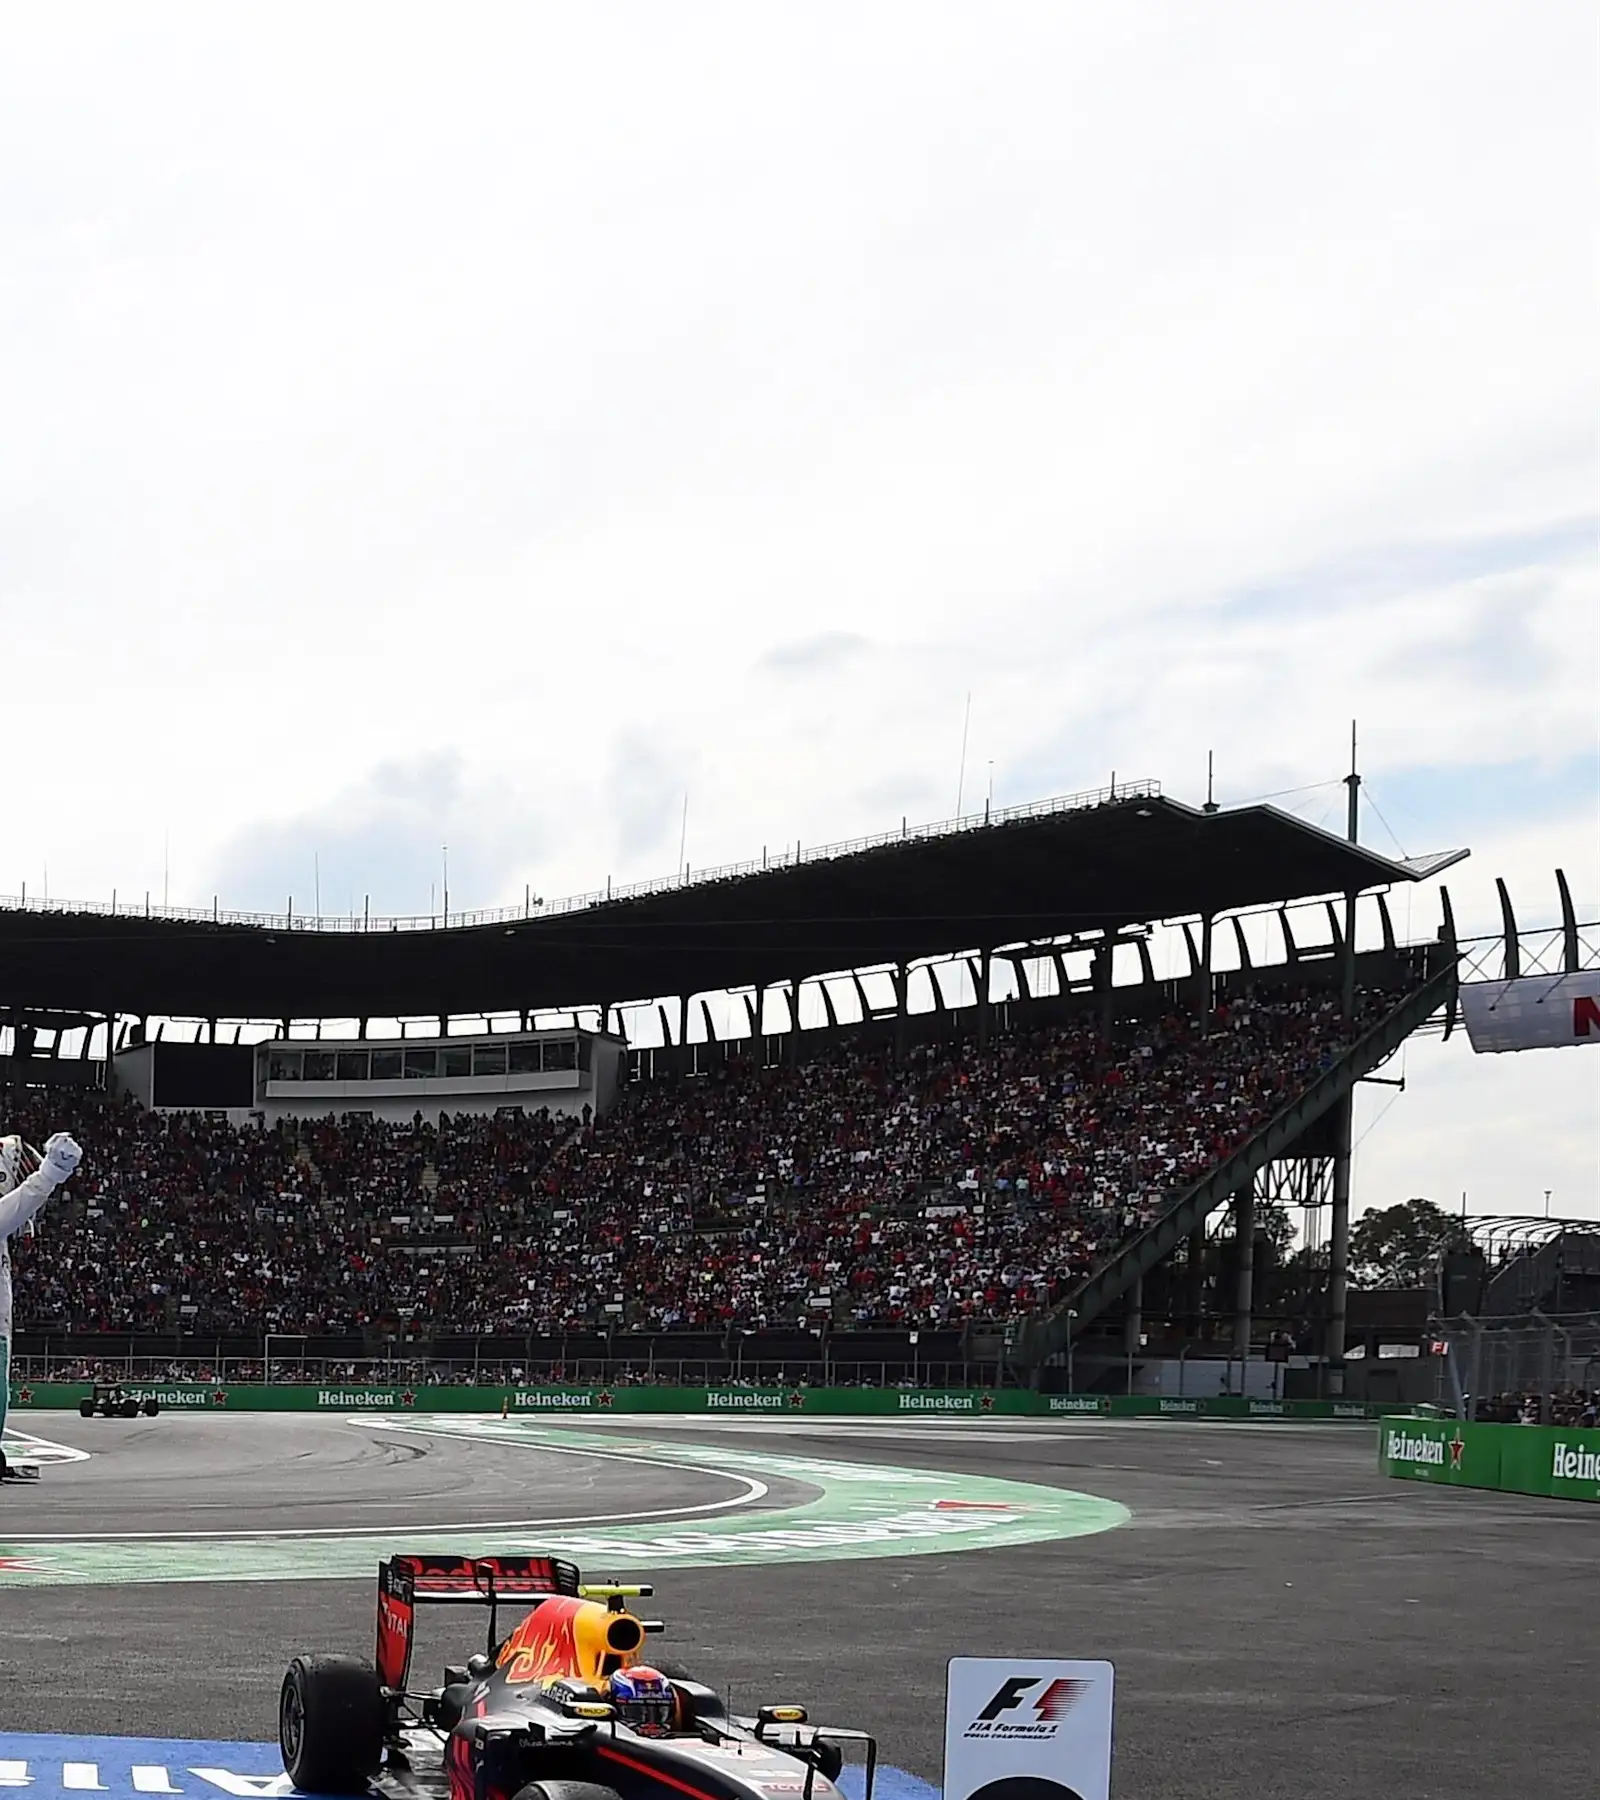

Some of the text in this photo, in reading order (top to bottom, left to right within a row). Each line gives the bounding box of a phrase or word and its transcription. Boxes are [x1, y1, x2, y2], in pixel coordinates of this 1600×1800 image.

[318, 1390, 394, 1405] Heineken
[514, 1391, 591, 1406] Heineken
[707, 1393, 781, 1407] Heineken
[899, 1395, 973, 1409] Heineken
[1049, 1398, 1098, 1410] Heineken
[1387, 1429, 1443, 1465] Heineken
[975, 1678, 1094, 1721] F1
[968, 1722, 992, 1732] FIA
[994, 1722, 1047, 1734] Formula
